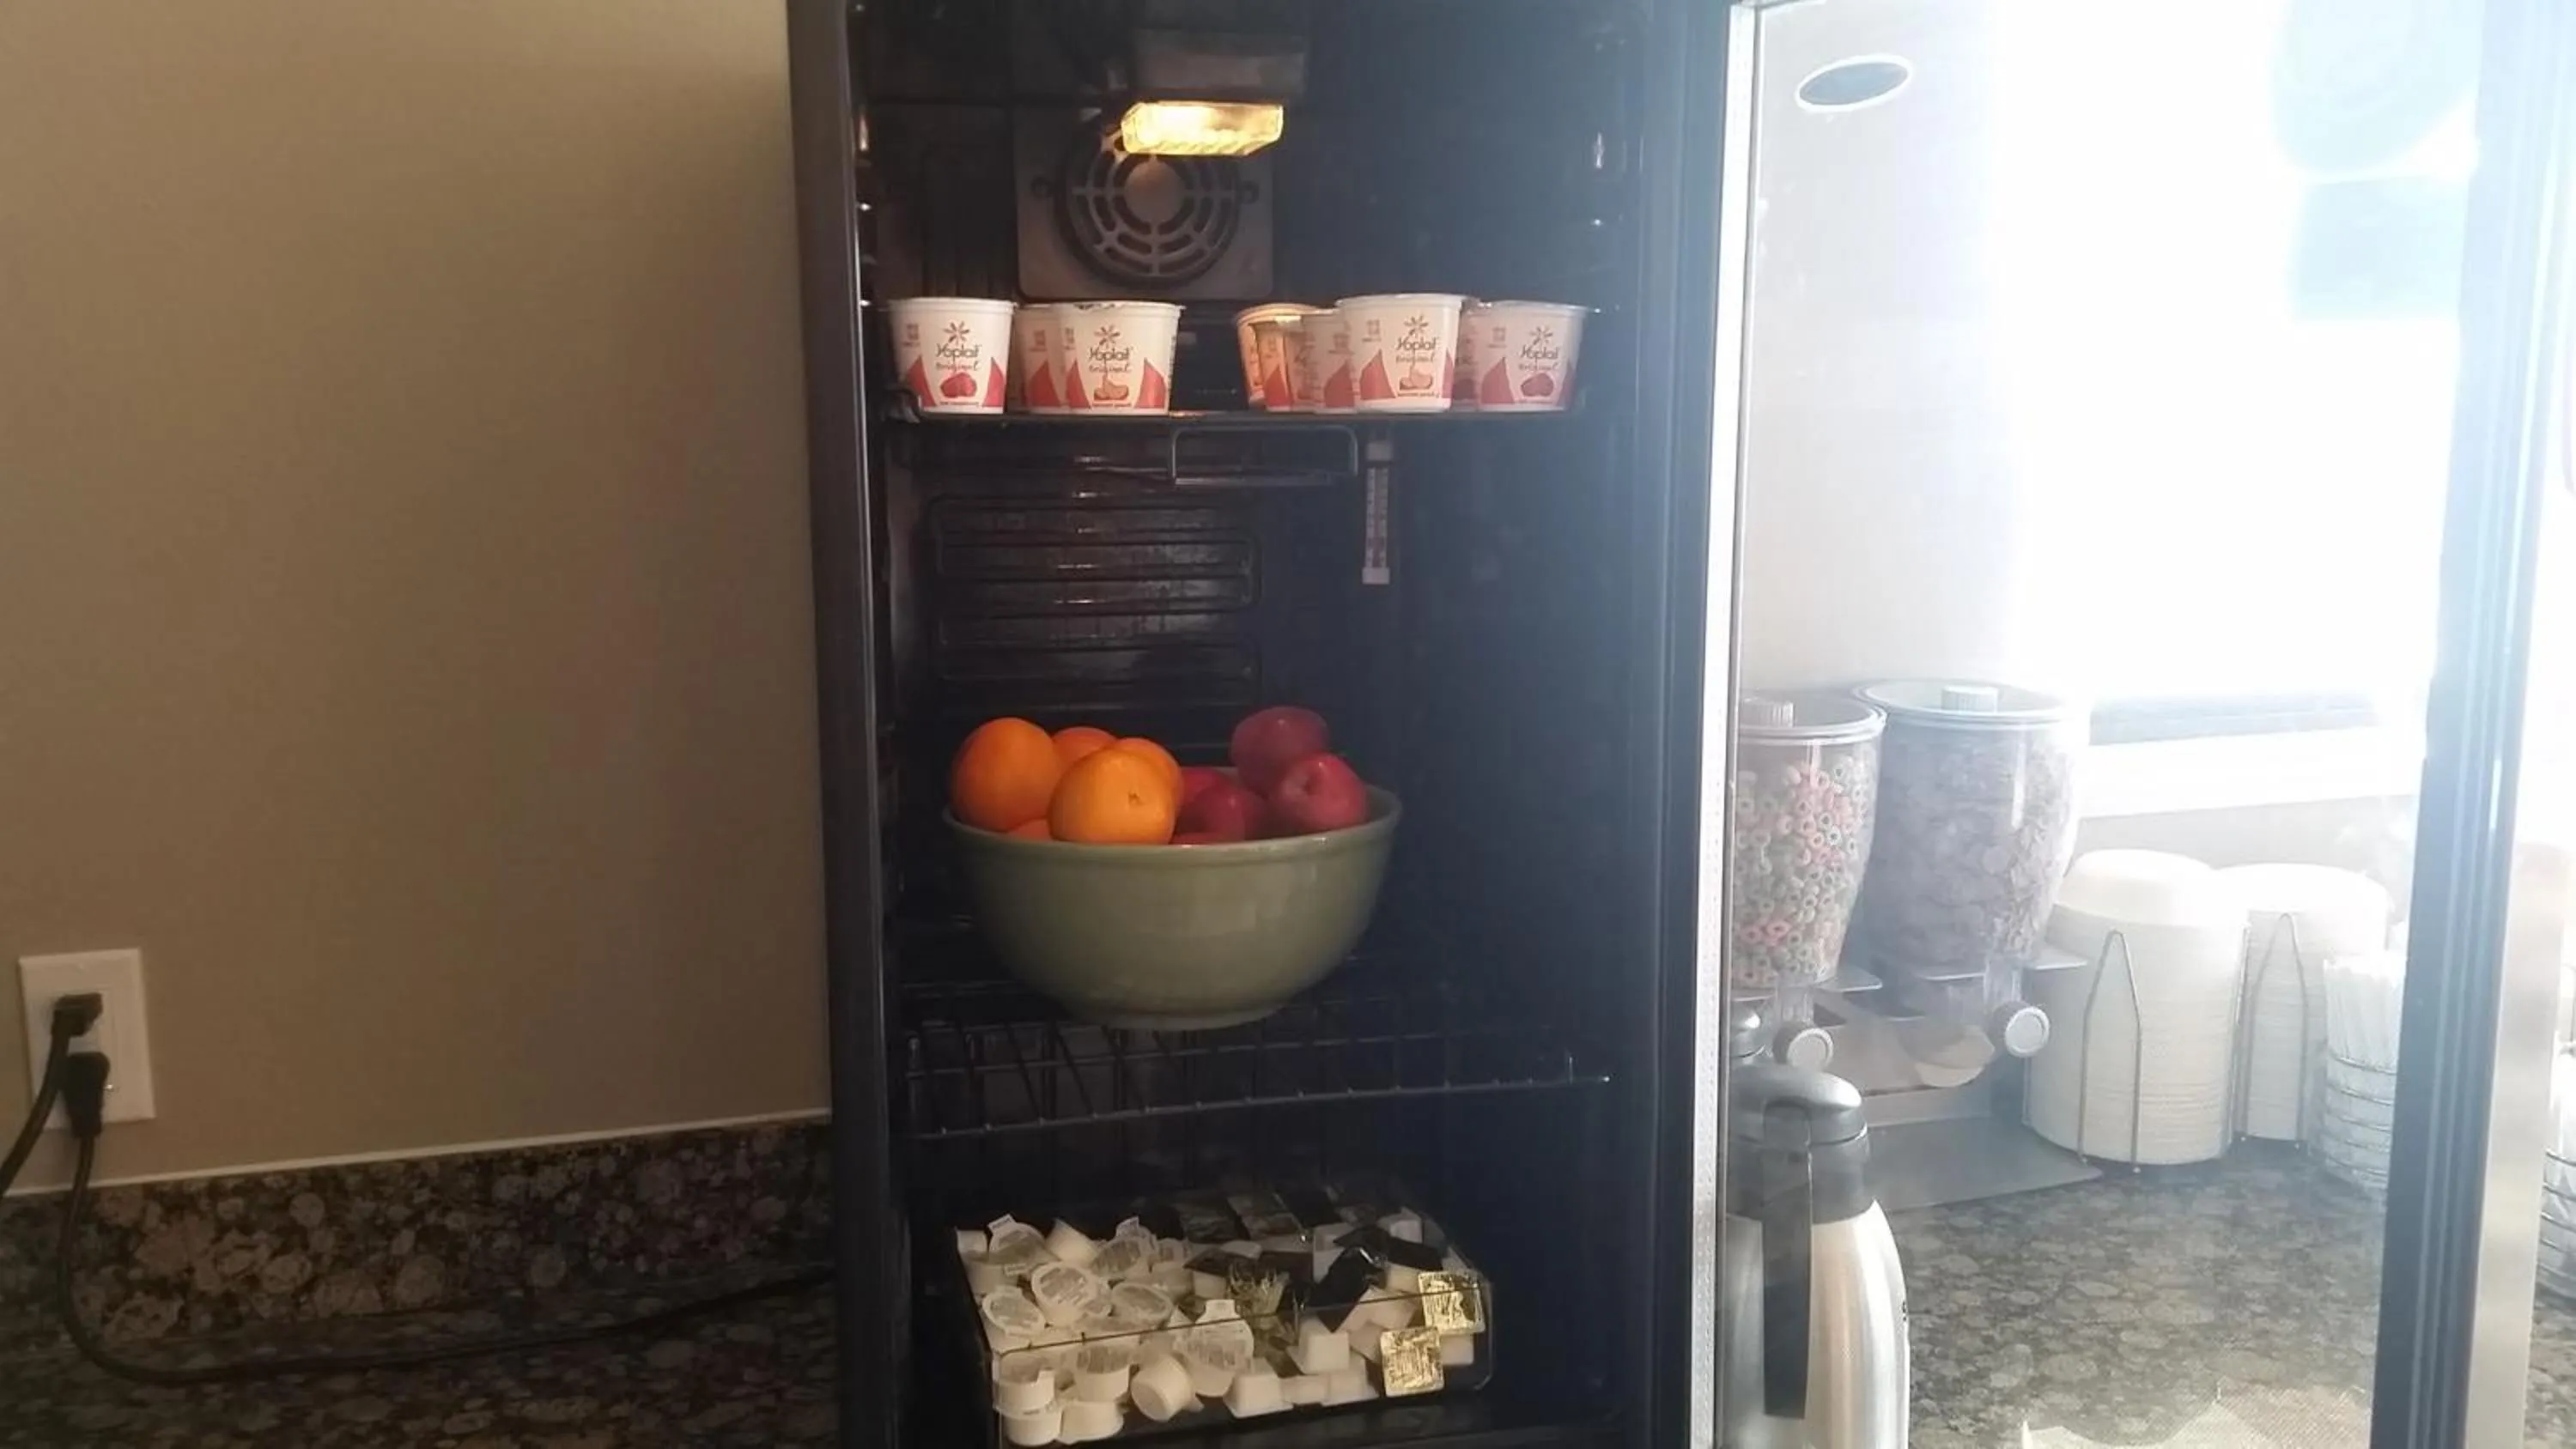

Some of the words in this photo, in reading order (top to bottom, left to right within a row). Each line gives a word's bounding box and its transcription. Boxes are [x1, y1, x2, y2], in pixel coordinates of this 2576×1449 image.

[936, 343, 981, 362] Yoplait
[1395, 336, 1437, 355] Yoplait
[1519, 344, 1559, 361] Yoplait
[1088, 346, 1131, 364] Yoplait
